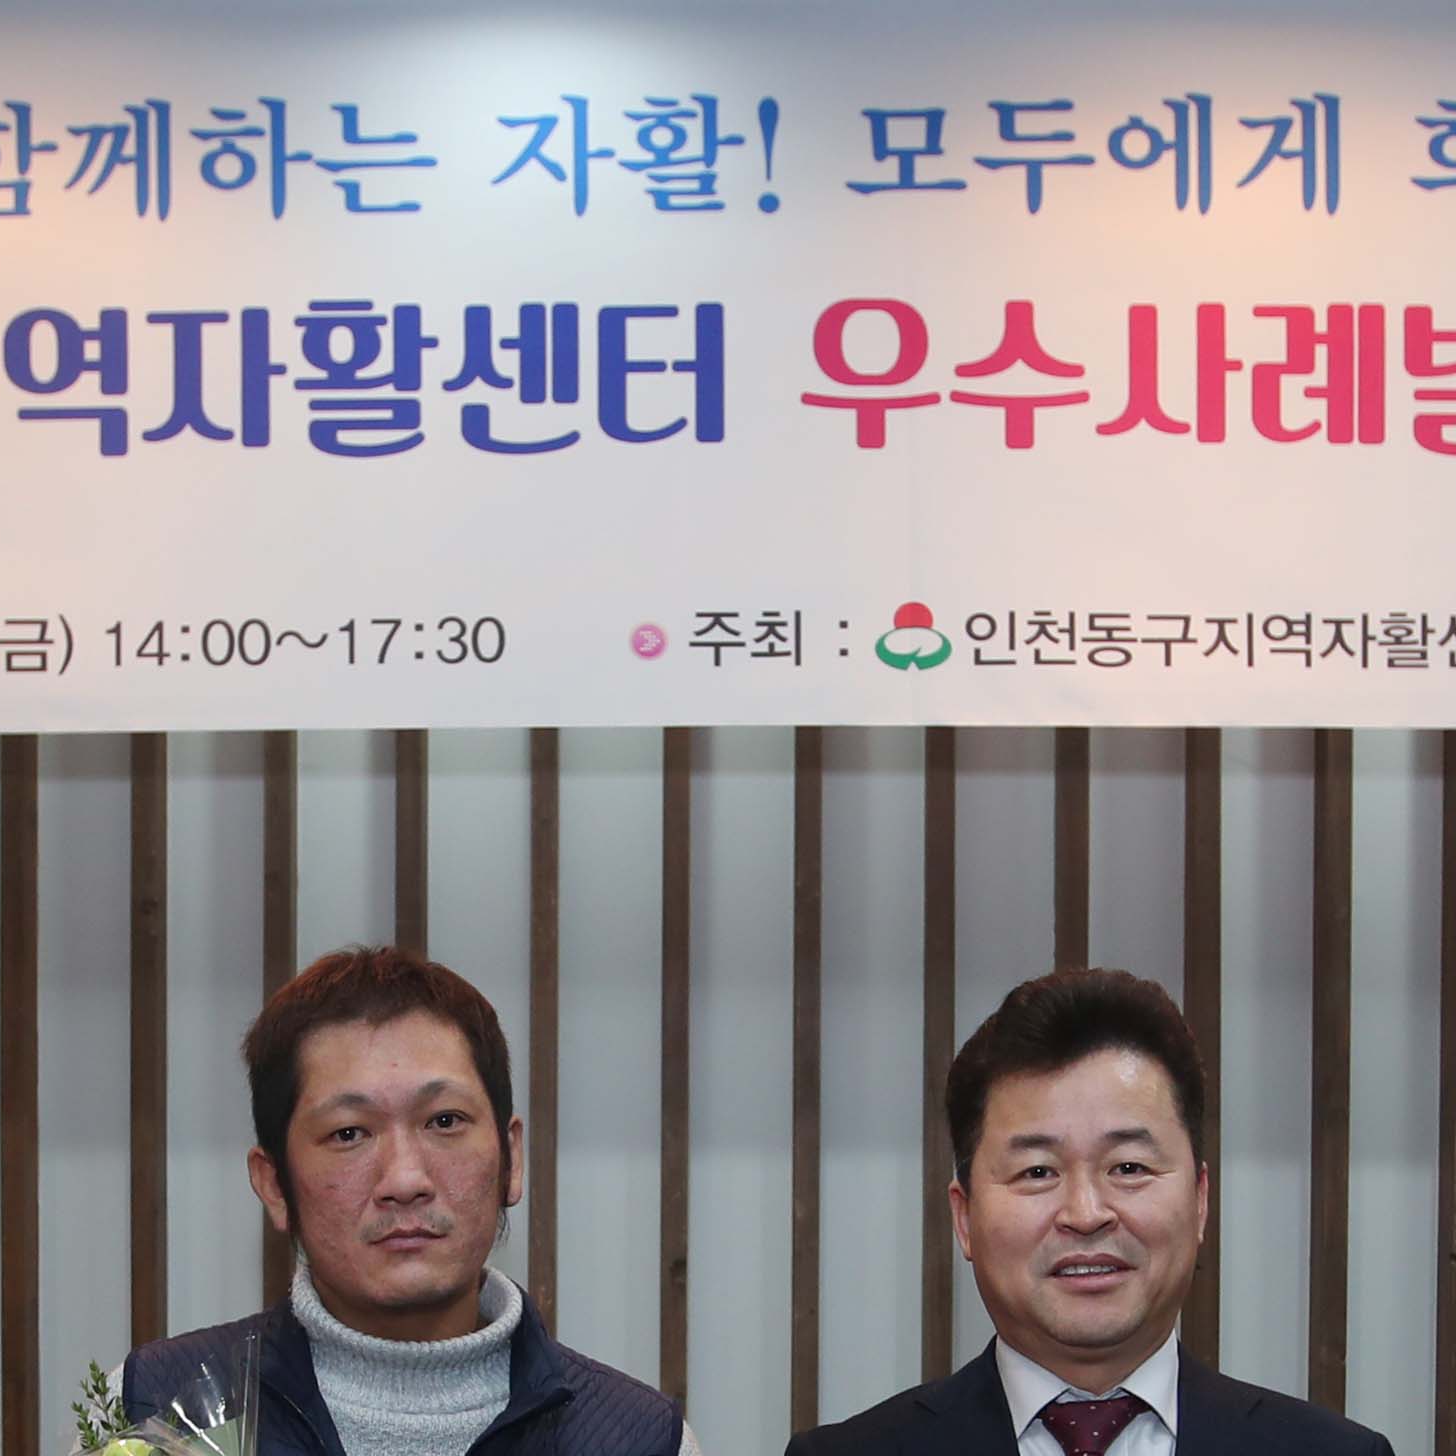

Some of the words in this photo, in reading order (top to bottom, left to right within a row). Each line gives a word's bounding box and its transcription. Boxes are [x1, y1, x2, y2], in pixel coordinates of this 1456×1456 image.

[494, 93, 780, 216] 자활!
[845, 92, 1340, 214] 모두에게
[107, 617, 505, 666] 14:00~17:30
[689, 611, 801, 666] 주최
